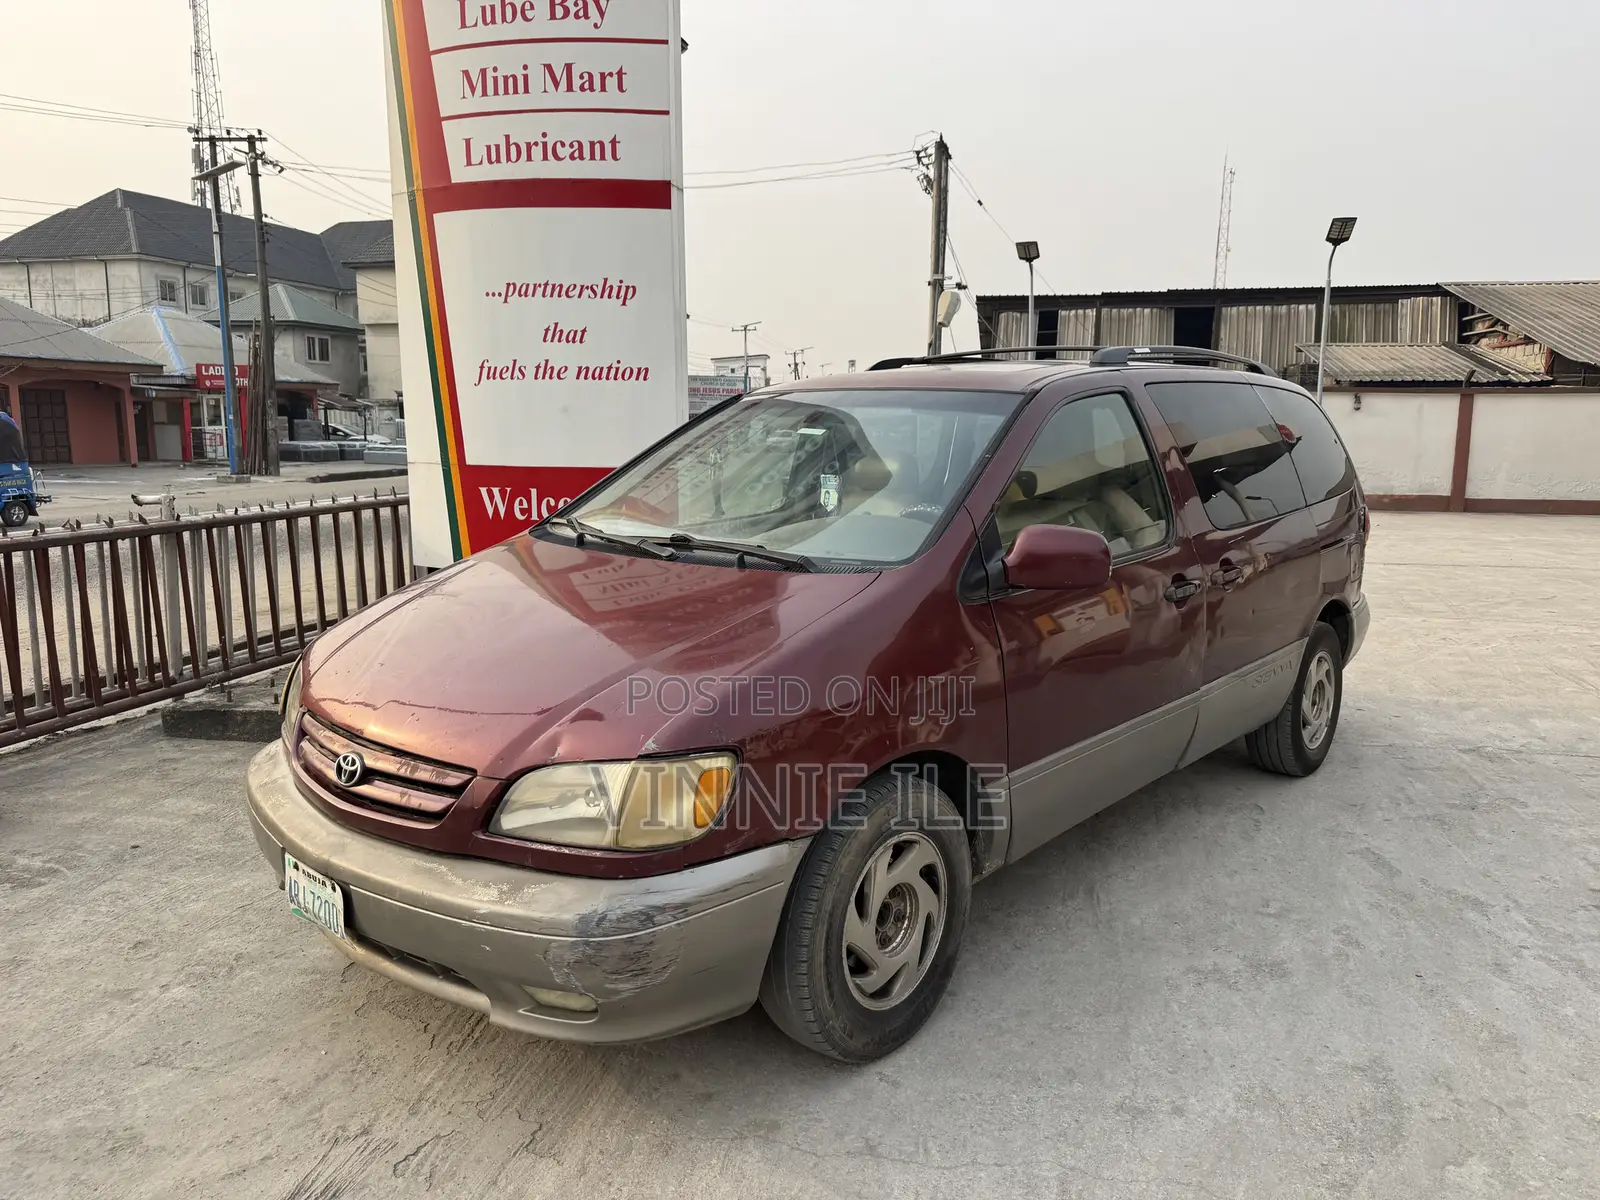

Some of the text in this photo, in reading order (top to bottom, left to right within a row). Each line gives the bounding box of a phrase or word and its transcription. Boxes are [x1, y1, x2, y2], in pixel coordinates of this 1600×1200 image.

[458, 0, 611, 29] Lube Bay
[460, 62, 628, 99] Mini Mart
[462, 131, 622, 168] Lubricant
[542, 322, 588, 344] that
[474, 359, 650, 386] fuels the nation
[478, 486, 572, 520] Welc
[302, 868, 327, 888] ABUJA
